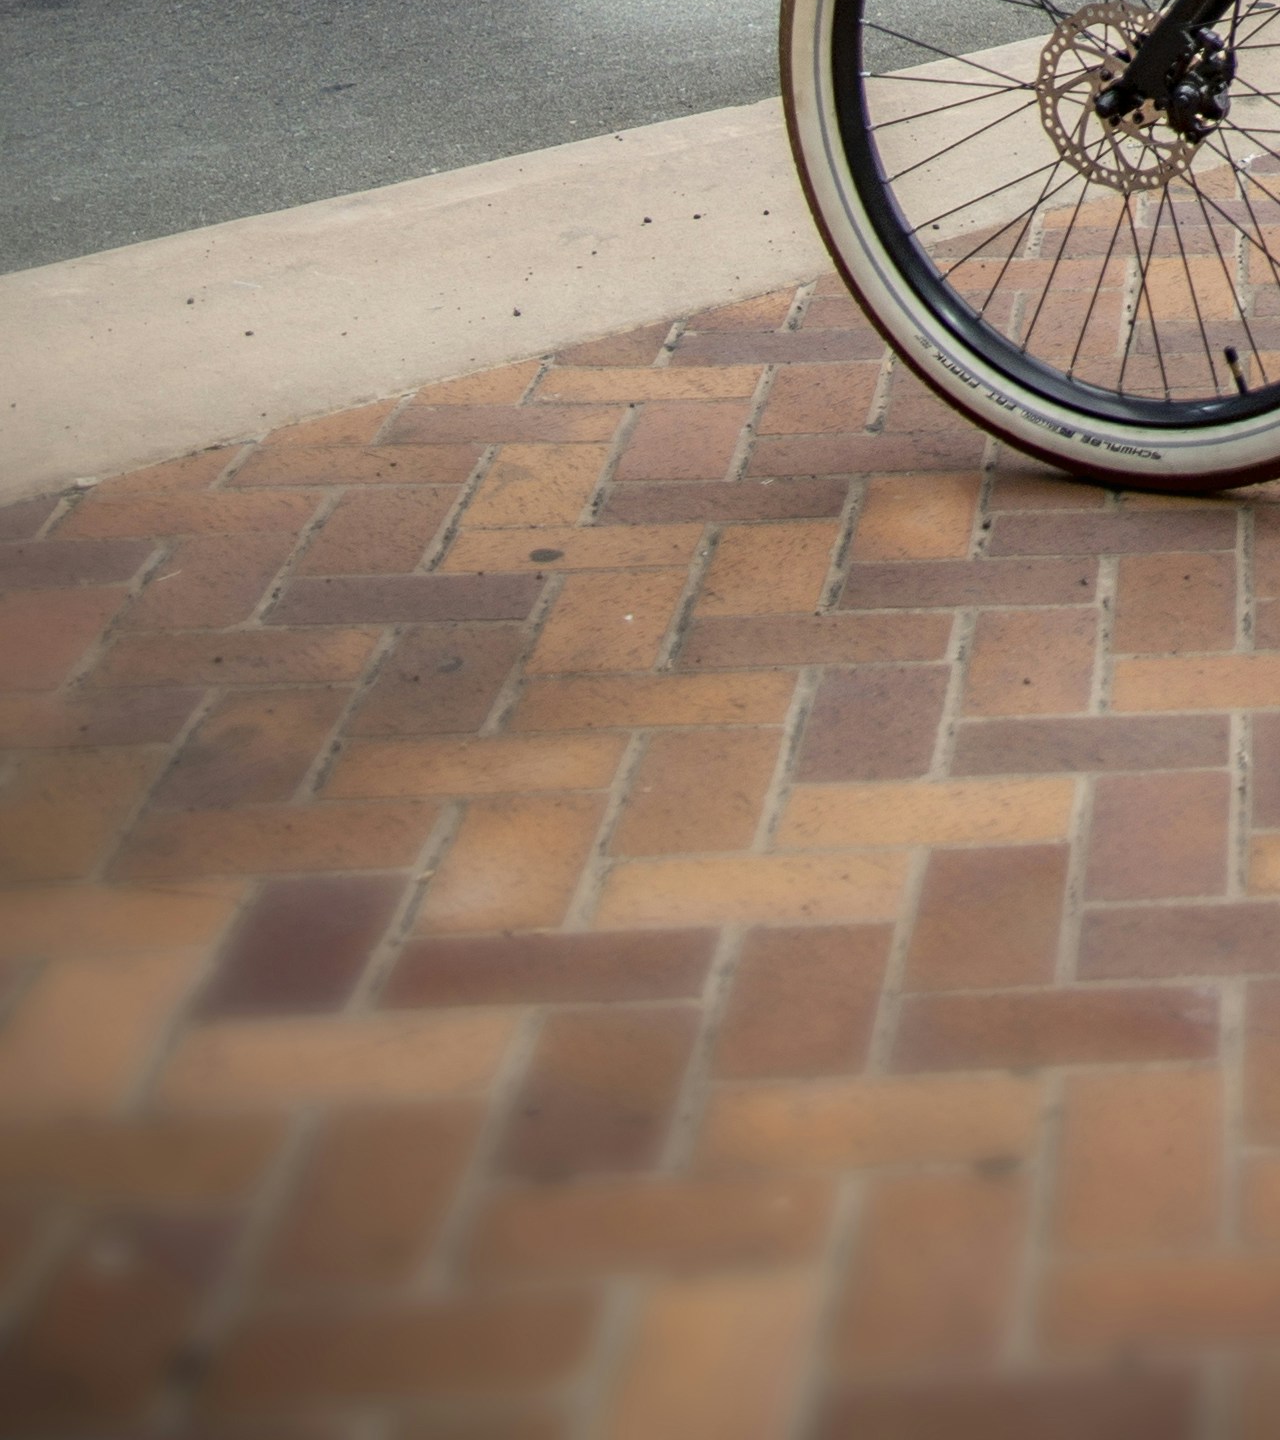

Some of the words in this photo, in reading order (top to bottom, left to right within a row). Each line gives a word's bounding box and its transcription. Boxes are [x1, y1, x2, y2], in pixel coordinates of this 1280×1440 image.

[932, 351, 982, 389] FRANK
[986, 391, 1017, 412] FAT
[1079, 434, 1162, 460] SCHWALBE
